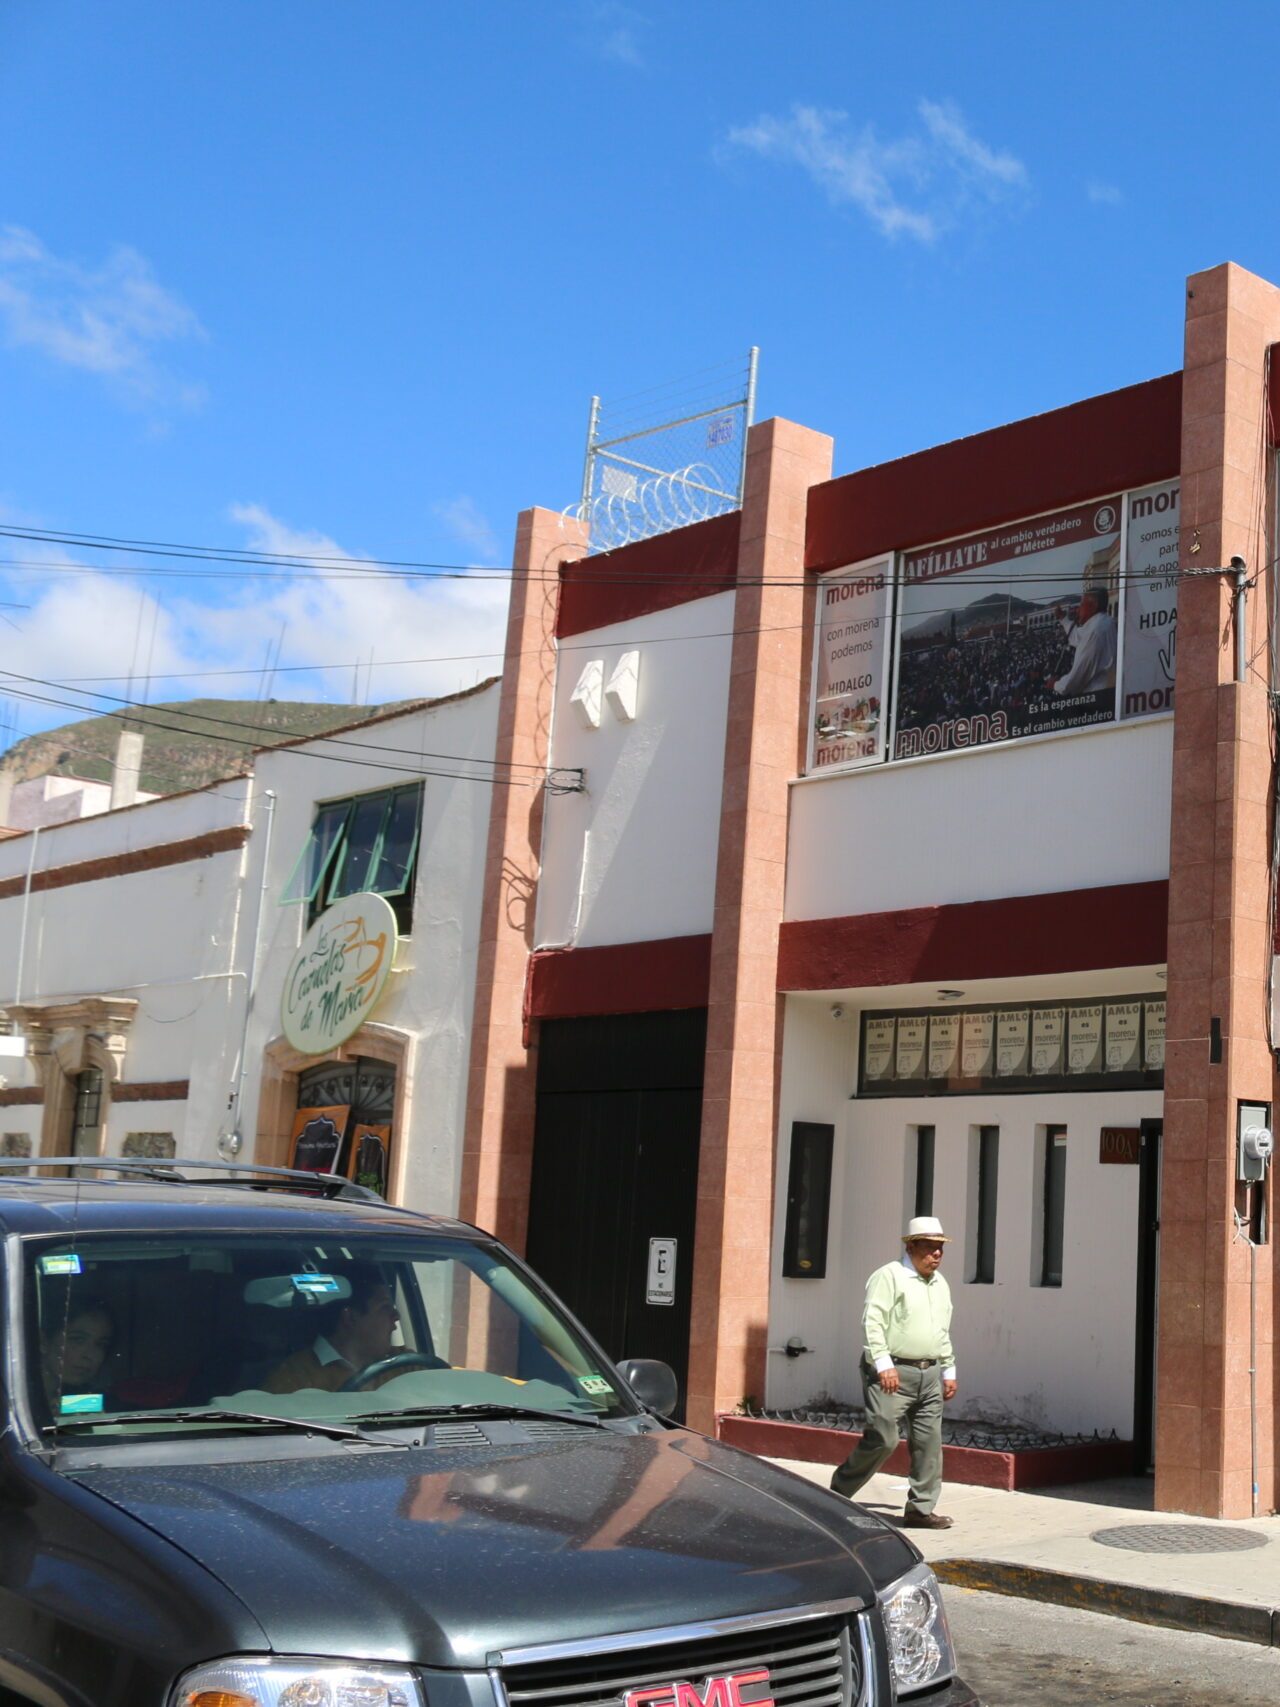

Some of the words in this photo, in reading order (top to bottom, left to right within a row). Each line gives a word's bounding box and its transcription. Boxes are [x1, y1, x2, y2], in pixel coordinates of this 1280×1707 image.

[1132, 488, 1180, 519] mor
[1140, 528, 1172, 543] somos
[904, 541, 988, 582] AFÍLIATE
[991, 538, 999, 549] al
[1001, 530, 1034, 547] cambio
[1036, 518, 1082, 537] verdadero
[1159, 542, 1179, 558] part
[1158, 561, 1179, 575] opo
[826, 572, 885, 605] morena
[1150, 581, 1162, 592] en
[1139, 609, 1178, 630] HIDA
[827, 628, 843, 642] con
[845, 617, 880, 635] morena
[831, 640, 873, 663] podemos
[828, 673, 872, 696] HIDALGO
[1028, 704, 1038, 714] Es
[1041, 701, 1049, 712] la
[1051, 694, 1096, 710] esperanza
[1125, 685, 1175, 716] mor
[1012, 726, 1021, 736] Es
[1023, 724, 1031, 734] el
[1033, 719, 1065, 733] cambio
[1067, 711, 1113, 727] verdadero
[895, 709, 1008, 759] morena
[816, 737, 875, 766] morena
[1035, 1010, 1064, 1020] AMLO
[1071, 1008, 1100, 1018] AMLO
[1108, 1005, 1139, 1016] AMLO
[1147, 1004, 1165, 1013] AM
[899, 1018, 926, 1028] AMLO
[931, 1016, 959, 1026] AMLO
[964, 1014, 993, 1024] AMLO
[999, 1012, 1028, 1022] AMLO
[868, 1020, 894, 1030] AMLO
[1147, 1028, 1166, 1036] more
[1109, 1030, 1136, 1038] morena
